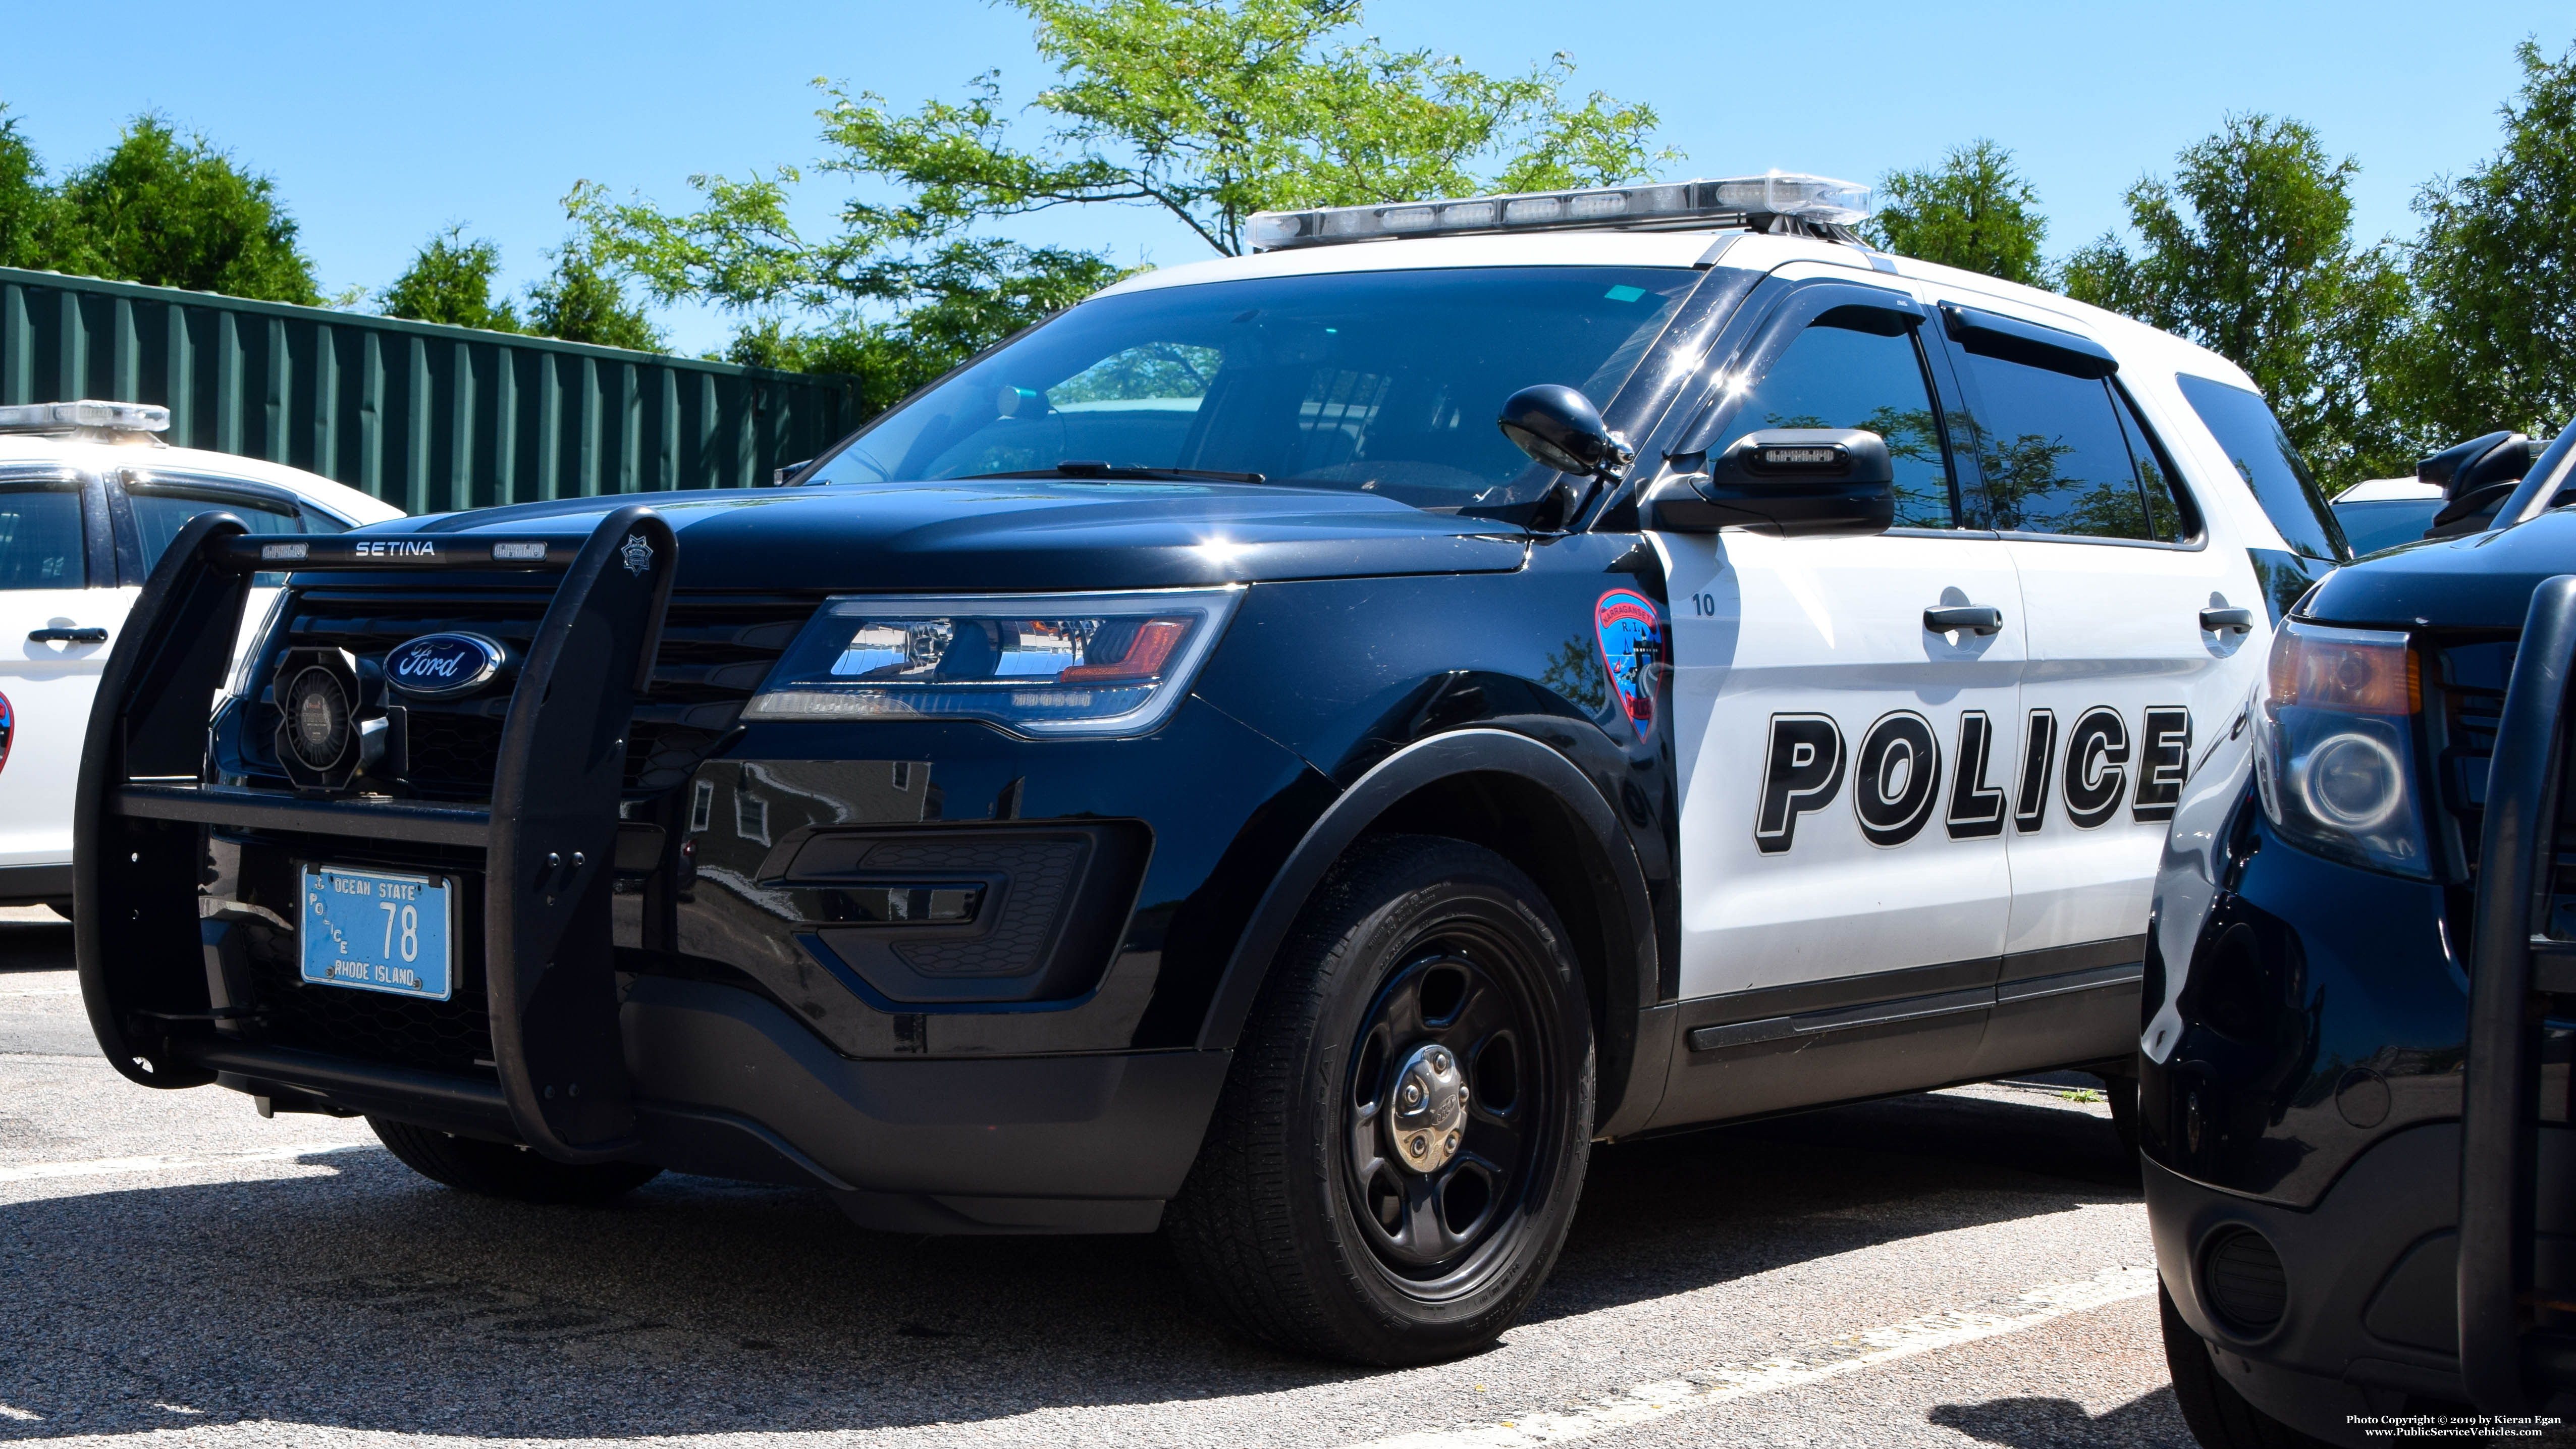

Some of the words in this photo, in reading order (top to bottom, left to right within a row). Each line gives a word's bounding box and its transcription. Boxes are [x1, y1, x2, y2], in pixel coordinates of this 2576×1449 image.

[356, 541, 435, 556] SETINA
[1603, 605, 1655, 625] NARRAGANSETT
[1692, 593, 1715, 617] 10
[1622, 622, 1631, 632] R.
[1632, 622, 1640, 632] I.
[399, 642, 465, 677] Ford
[1751, 705, 2193, 857] POLICE
[334, 877, 370, 896] OCEAN
[379, 883, 416, 901] STATE
[380, 901, 417, 962] 78
[335, 959, 369, 980] RHODE
[375, 964, 414, 987] ISLAND
